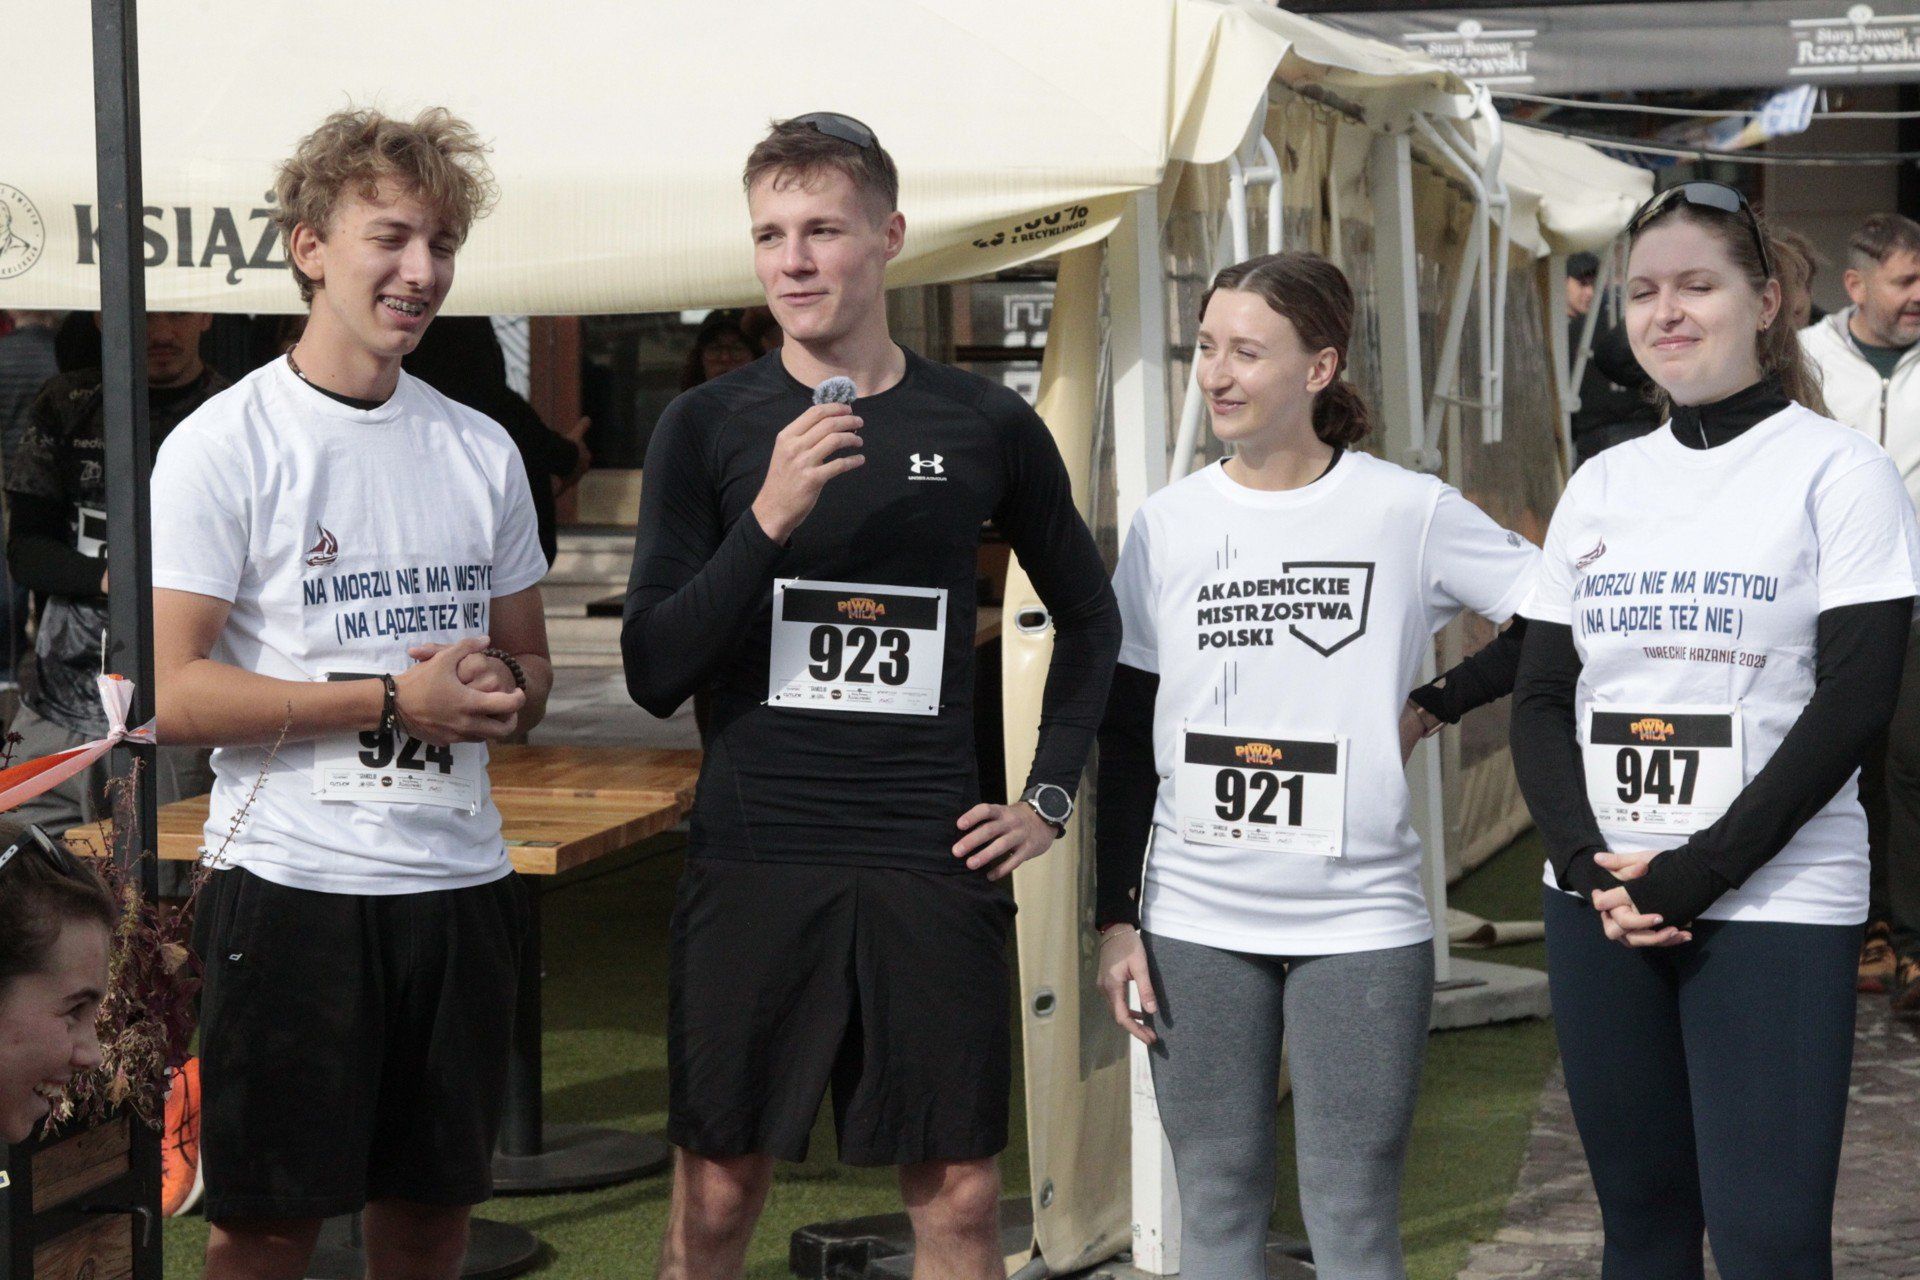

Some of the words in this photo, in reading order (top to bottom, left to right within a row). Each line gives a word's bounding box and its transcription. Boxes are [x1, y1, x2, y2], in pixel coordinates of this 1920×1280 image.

[1021, 219, 1087, 242] RECYKLINGU
[303, 577, 328, 606] NA
[332, 570, 393, 602] MORZU
[396, 567, 421, 596] NIE
[427, 566, 452, 593] MA
[1197, 577, 1350, 603] AKADEMICKIE
[1584, 572, 1636, 599] MORZU
[1640, 570, 1667, 595] NIE
[1671, 570, 1697, 594] MA
[1703, 571, 1779, 602] WSTYDU
[375, 605, 429, 641] LĄDZIE
[429, 596, 458, 631] TEŻ
[837, 598, 886, 616] PIWNA
[1197, 602, 1354, 626] MISTRZOSTWA
[1611, 605, 1662, 637] LĄDZIE
[1669, 598, 1699, 631] TEŻ
[1198, 628, 1274, 651] POLSKI
[808, 624, 911, 686] 923
[1643, 645, 1687, 661] TURECKIE
[1689, 647, 1736, 665] KAZANIE
[1739, 651, 1767, 669] 2025
[1630, 718, 1675, 736] PIWNA
[358, 731, 454, 775] 924
[1235, 742, 1283, 760] PIWNA
[1616, 747, 1700, 806] 947
[1215, 768, 1304, 827] 921
